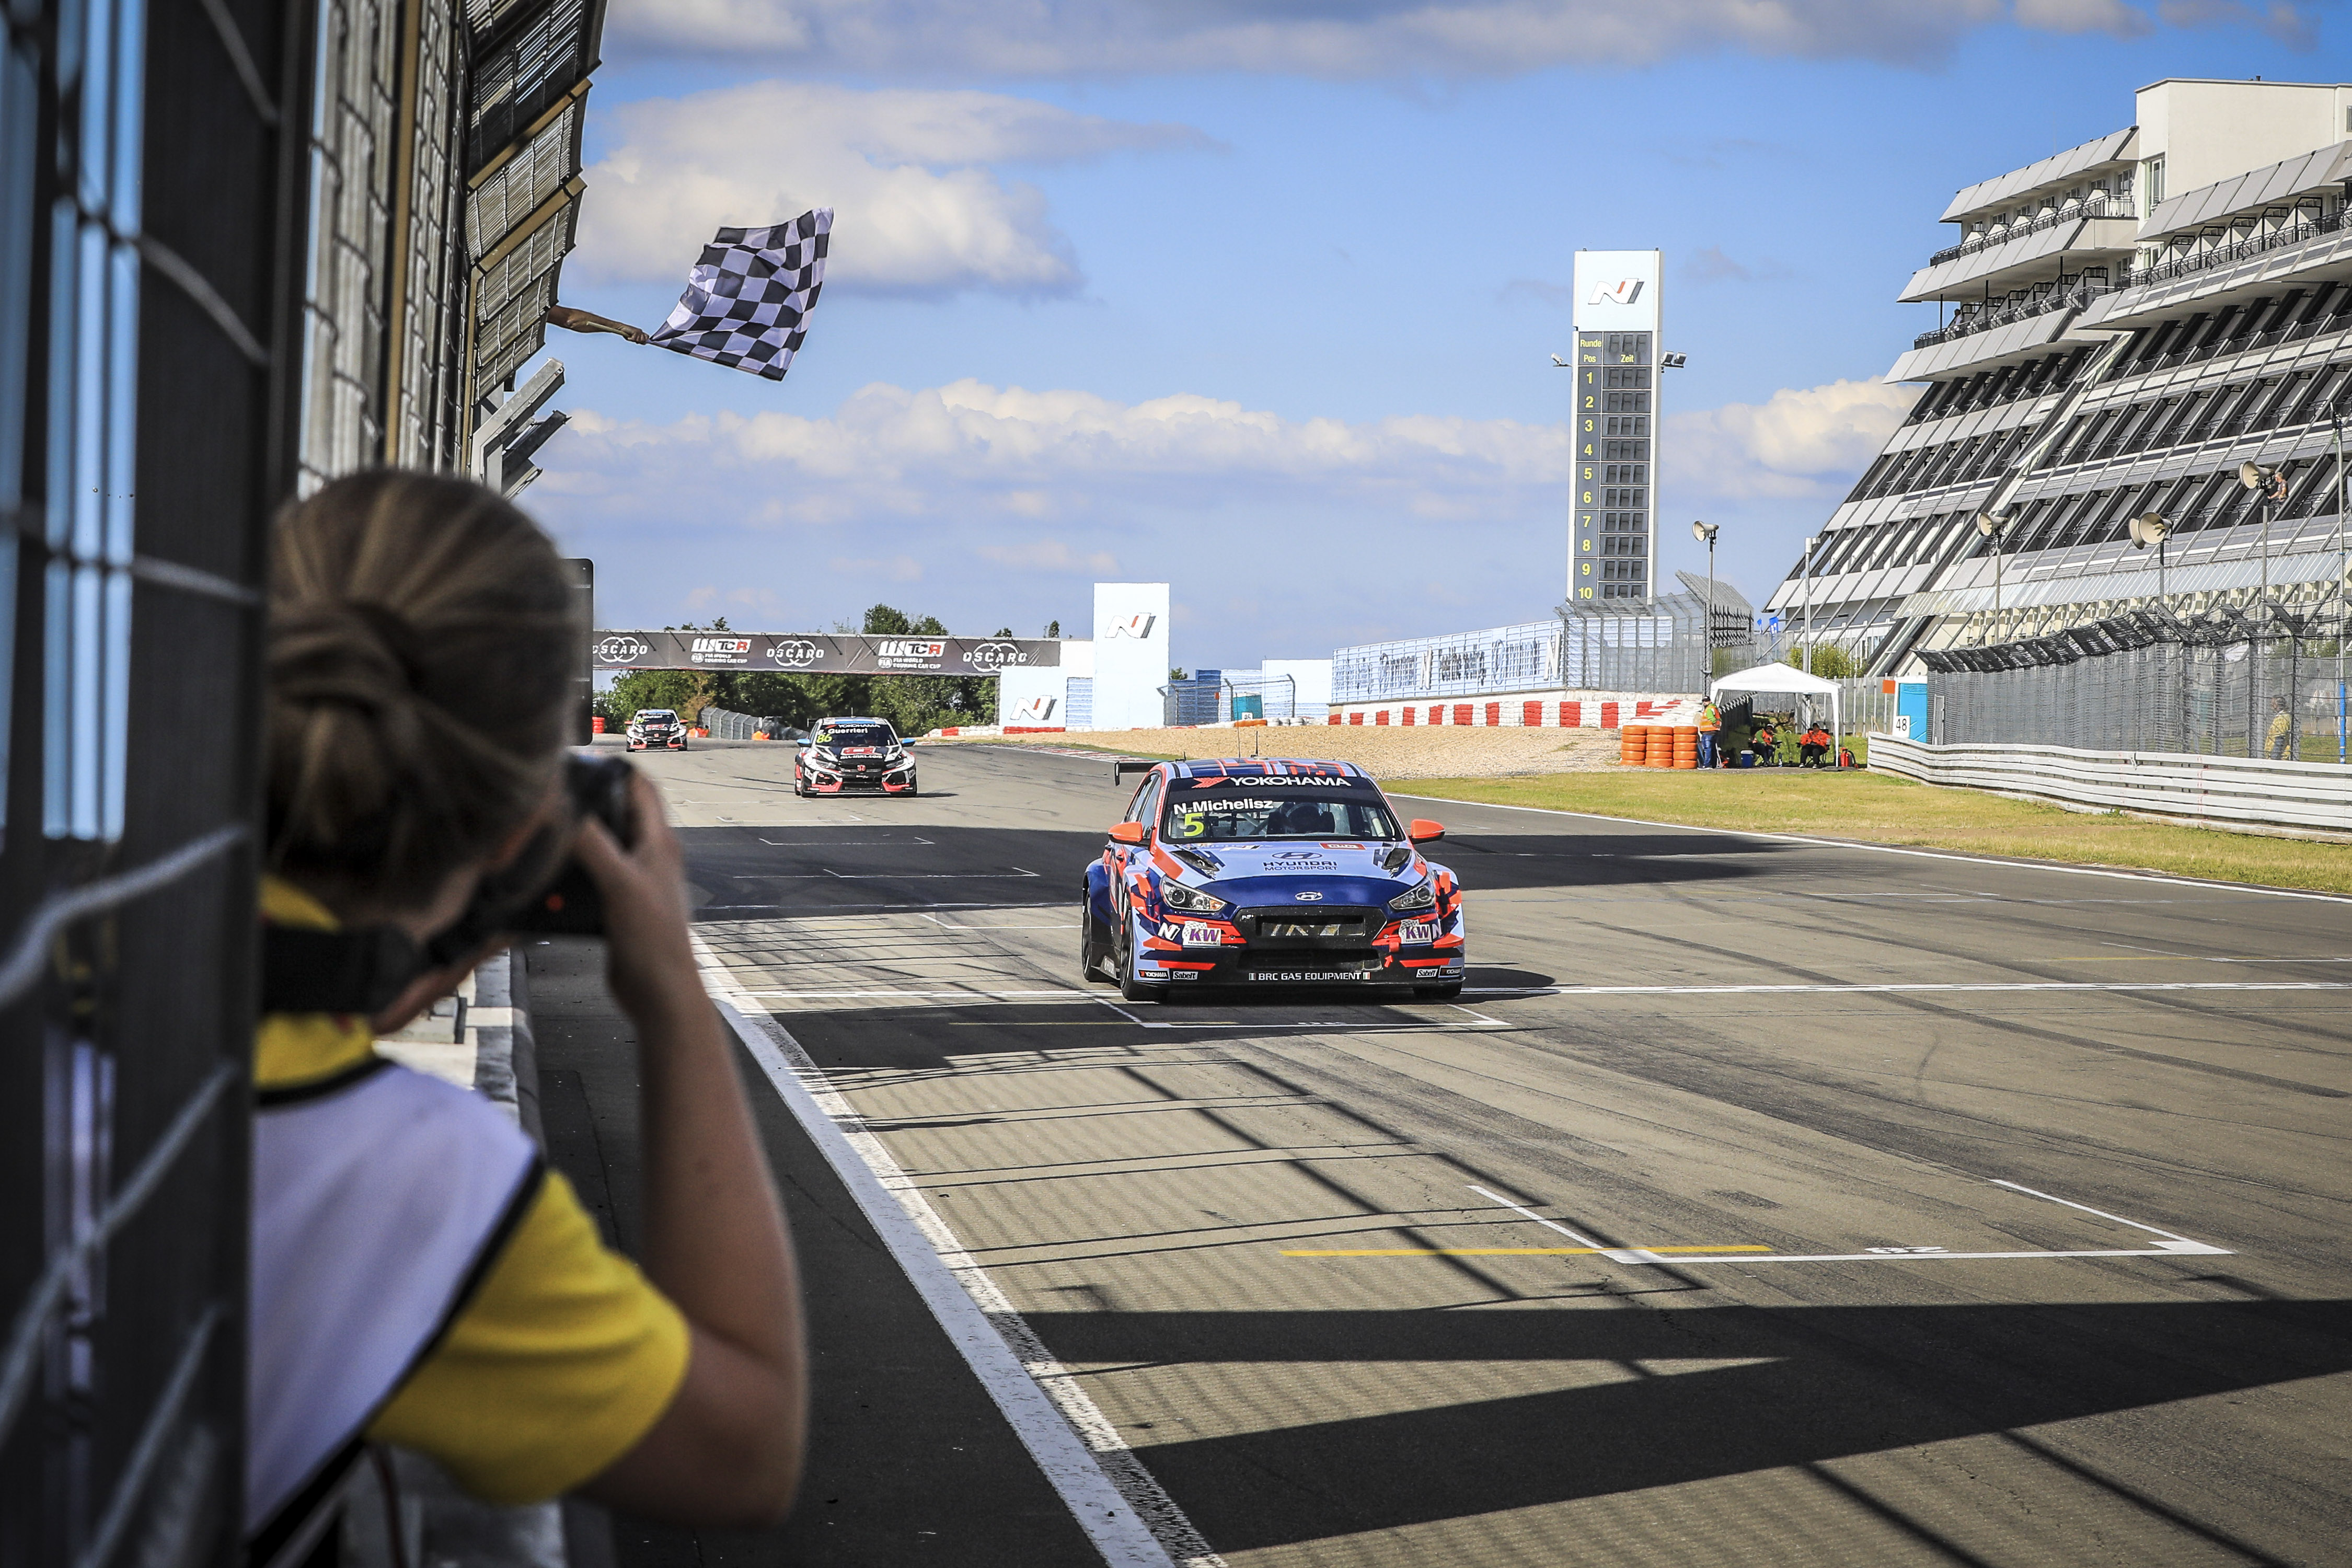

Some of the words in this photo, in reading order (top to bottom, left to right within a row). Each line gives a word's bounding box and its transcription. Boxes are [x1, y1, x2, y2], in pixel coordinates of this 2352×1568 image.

[1580, 339, 1601, 348] Runde
[1584, 354, 1596, 363] Pos
[1620, 354, 1634, 363] Zeit
[1587, 372, 1593, 384] 1
[1585, 396, 1594, 408] 2
[1585, 420, 1593, 432] 3
[1584, 444, 1593, 456] 4
[1584, 468, 1593, 479] 5
[1583, 491, 1592, 503] 6
[1583, 515, 1592, 527] 7
[1582, 539, 1591, 551] 8
[1582, 563, 1590, 575] 9
[1578, 587, 1593, 599] 10
[766, 648, 825, 659] OSCARO
[962, 652, 1028, 663] OSCARO
[1896, 718, 1907, 731] 48
[816, 733, 832, 743] 86
[1230, 777, 1352, 787] YOKOHAMA
[1173, 798, 1274, 815] N.Michelisz
[1183, 812, 1205, 837] 5
[1189, 928, 1219, 942] KW
[1406, 926, 1429, 939] KW
[1174, 971, 1197, 979] Sabelt
[1305, 972, 1361, 981] EQUIPMENT
